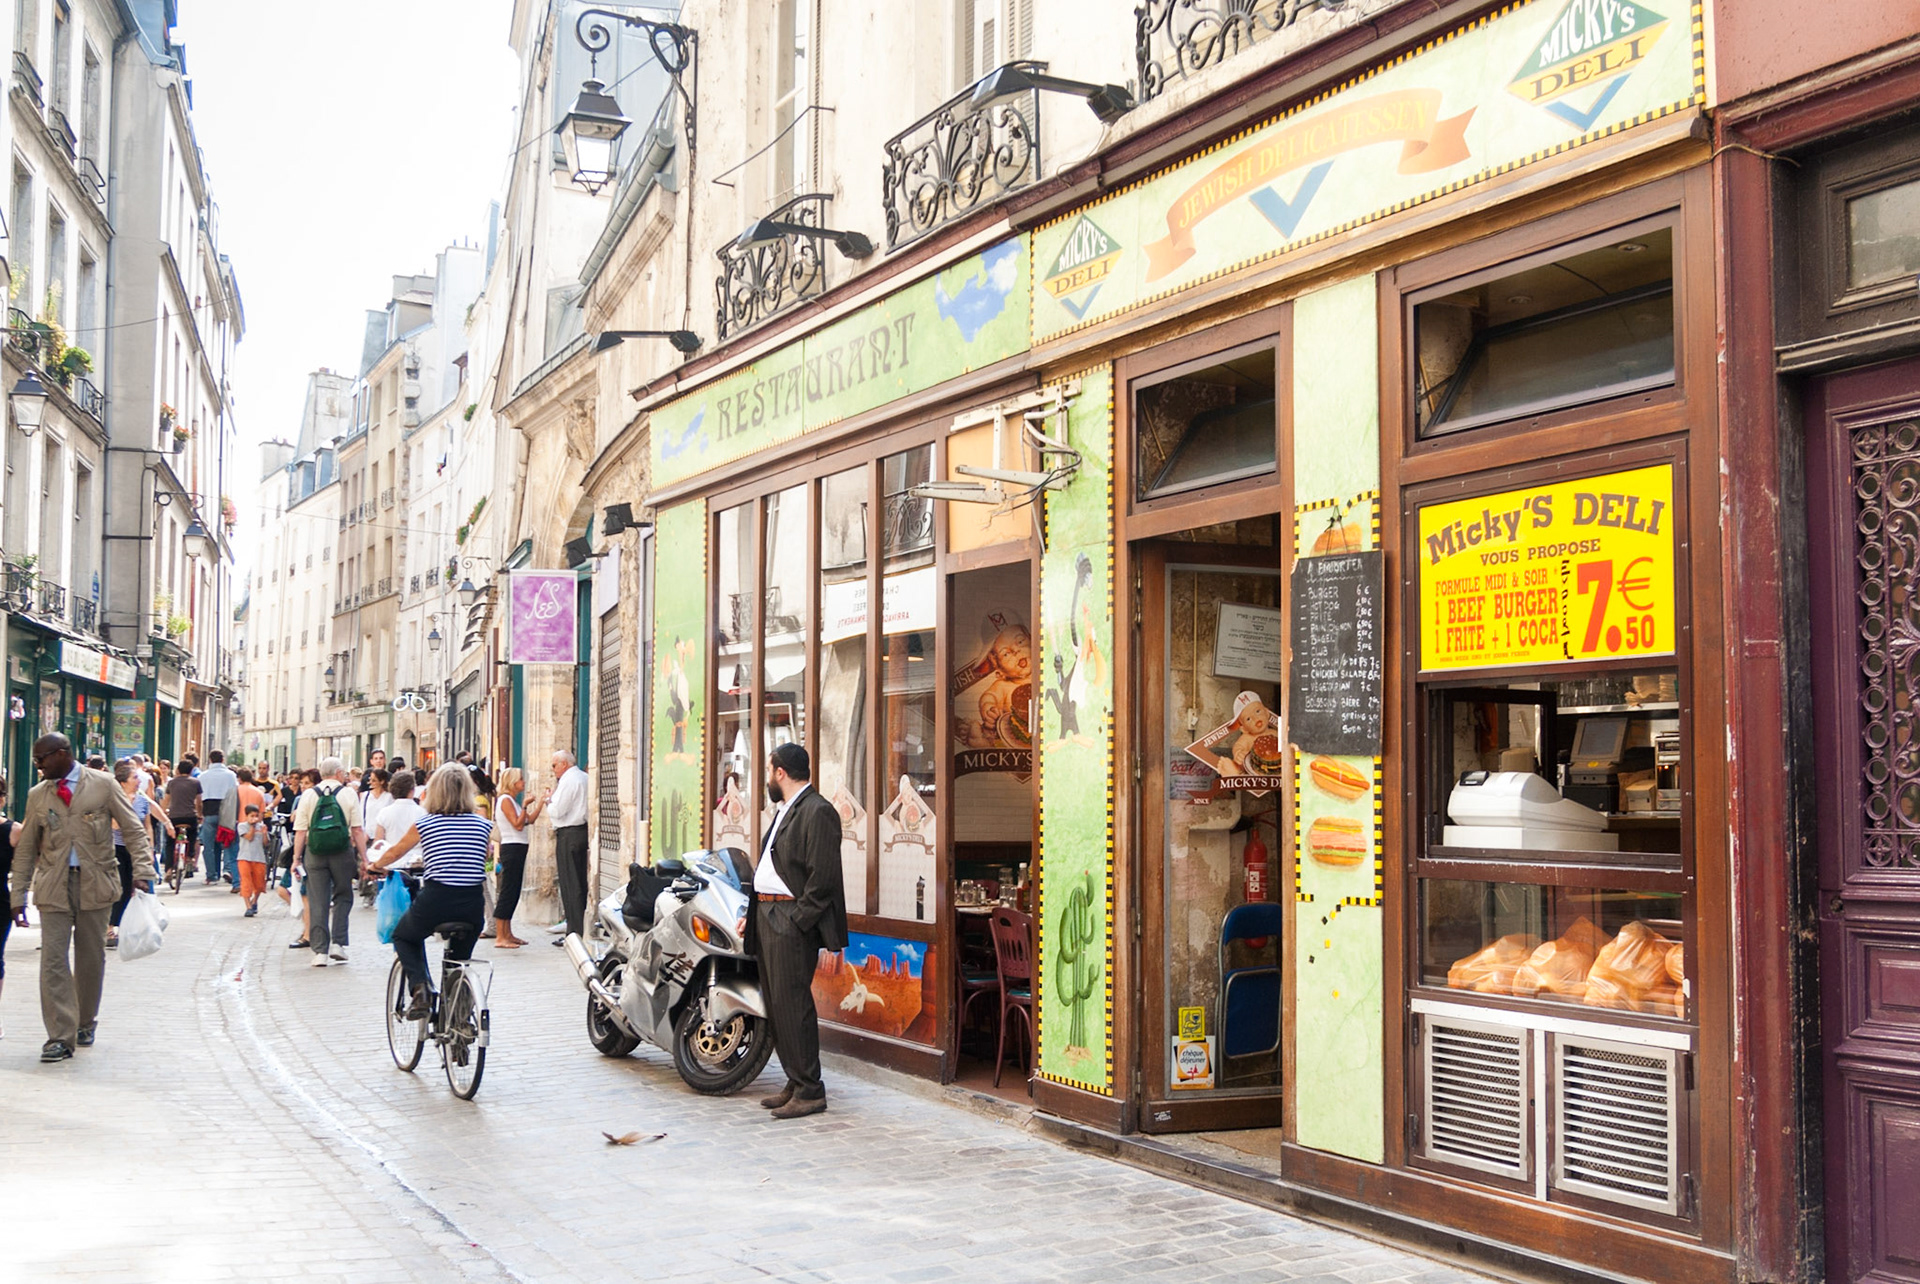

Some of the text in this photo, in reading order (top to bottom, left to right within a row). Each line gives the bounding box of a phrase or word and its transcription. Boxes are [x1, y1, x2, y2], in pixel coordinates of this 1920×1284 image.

[1530, 36, 1646, 101] DELI
[1178, 100, 1430, 228] JEWISH DELICATESSEN
[1054, 259, 1111, 296] DELI
[717, 312, 916, 441] RESTAURANT
[1573, 492, 1665, 535] DELI
[1480, 538, 1601, 566] VOUS PROPOSE
[1308, 586, 1339, 600] BURGER
[1435, 568, 1548, 597] FORMULE MIDI & SOIR
[1435, 587, 1558, 625] 1 BEEF BURGER
[1435, 629, 1440, 653] 1
[1446, 624, 1485, 653] FRITE
[1506, 622, 1511, 648] 1
[1518, 617, 1559, 648] COCA
[1311, 669, 1338, 679] CHICKEN
[1340, 669, 1367, 679] SALADE
[1203, 727, 1229, 747] JEWISH
[1220, 777, 1268, 789] MICKY'S
[1180, 1056, 1206, 1065] déjeuner
[1182, 1049, 1204, 1058] chèque
